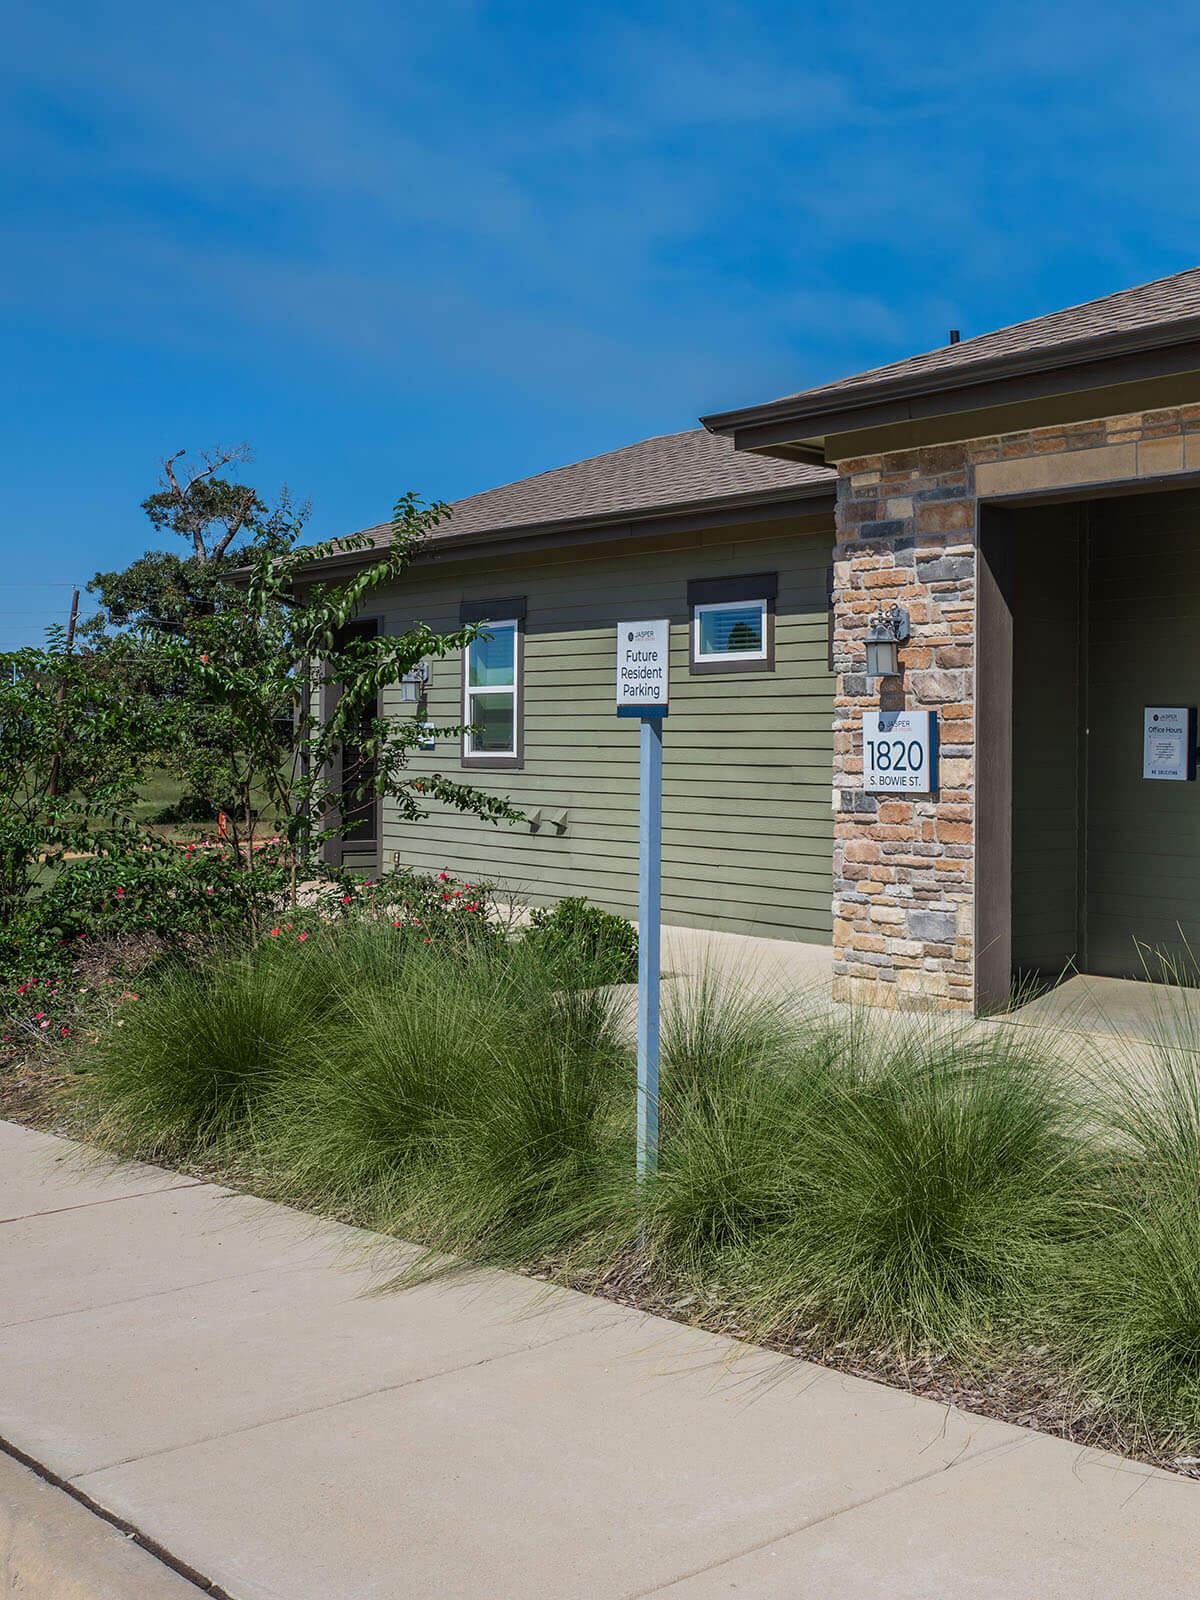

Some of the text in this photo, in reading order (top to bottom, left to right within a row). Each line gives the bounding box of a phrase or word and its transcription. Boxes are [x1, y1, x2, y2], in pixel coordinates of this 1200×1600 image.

[635, 630, 654, 638] JASPER
[626, 650, 658, 662] Future
[621, 666, 662, 679] Resident
[624, 683, 660, 699] Parking
[887, 720, 911, 728] JASPER
[1148, 726, 1165, 734] Office
[867, 740, 923, 771] 1820
[870, 776, 921, 786] S. BOWIE ST.
